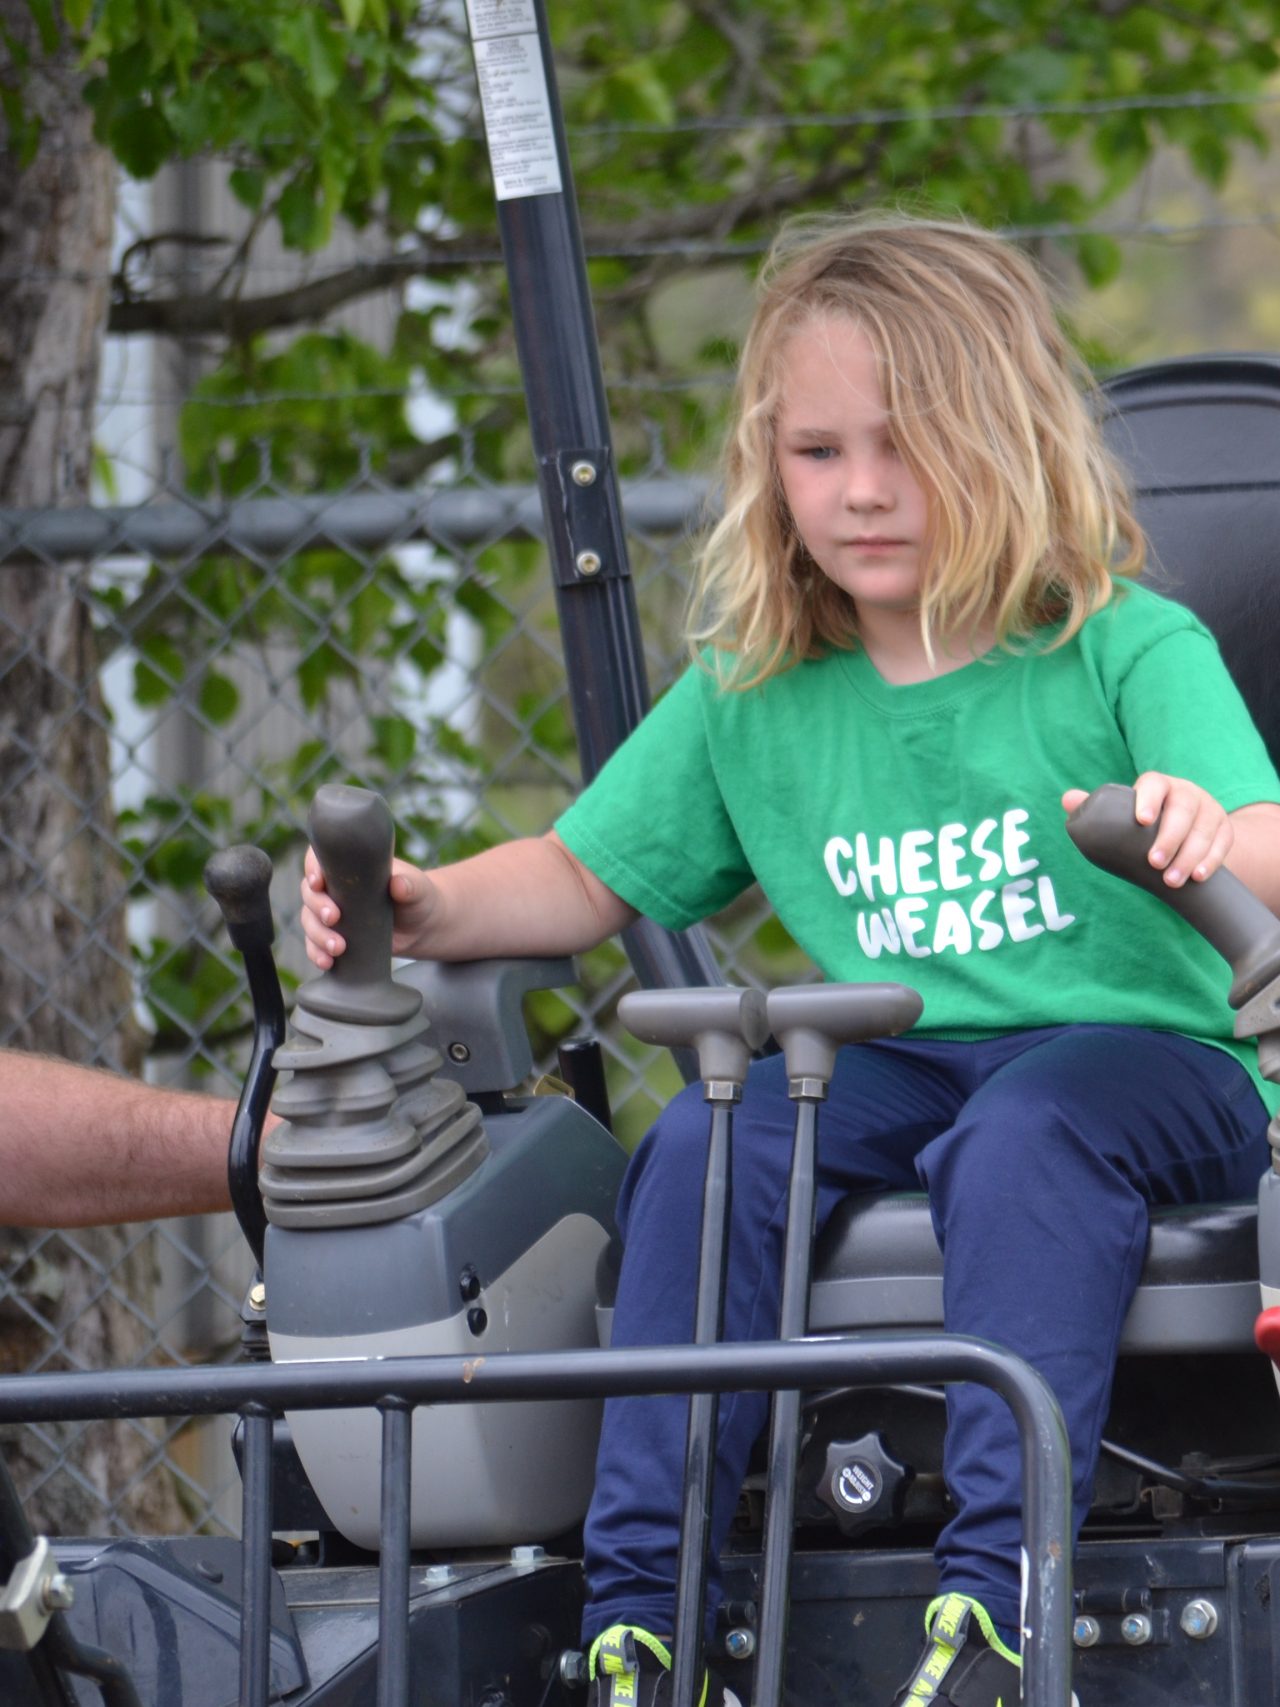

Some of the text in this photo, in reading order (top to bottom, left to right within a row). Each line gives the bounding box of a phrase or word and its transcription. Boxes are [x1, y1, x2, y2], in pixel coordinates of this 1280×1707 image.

[824, 809, 1039, 901] CHEESE
[857, 876, 1075, 959] WEASEL
[852, 1464, 874, 1491] WEIGHT
[938, 1599, 966, 1638] NIKE
